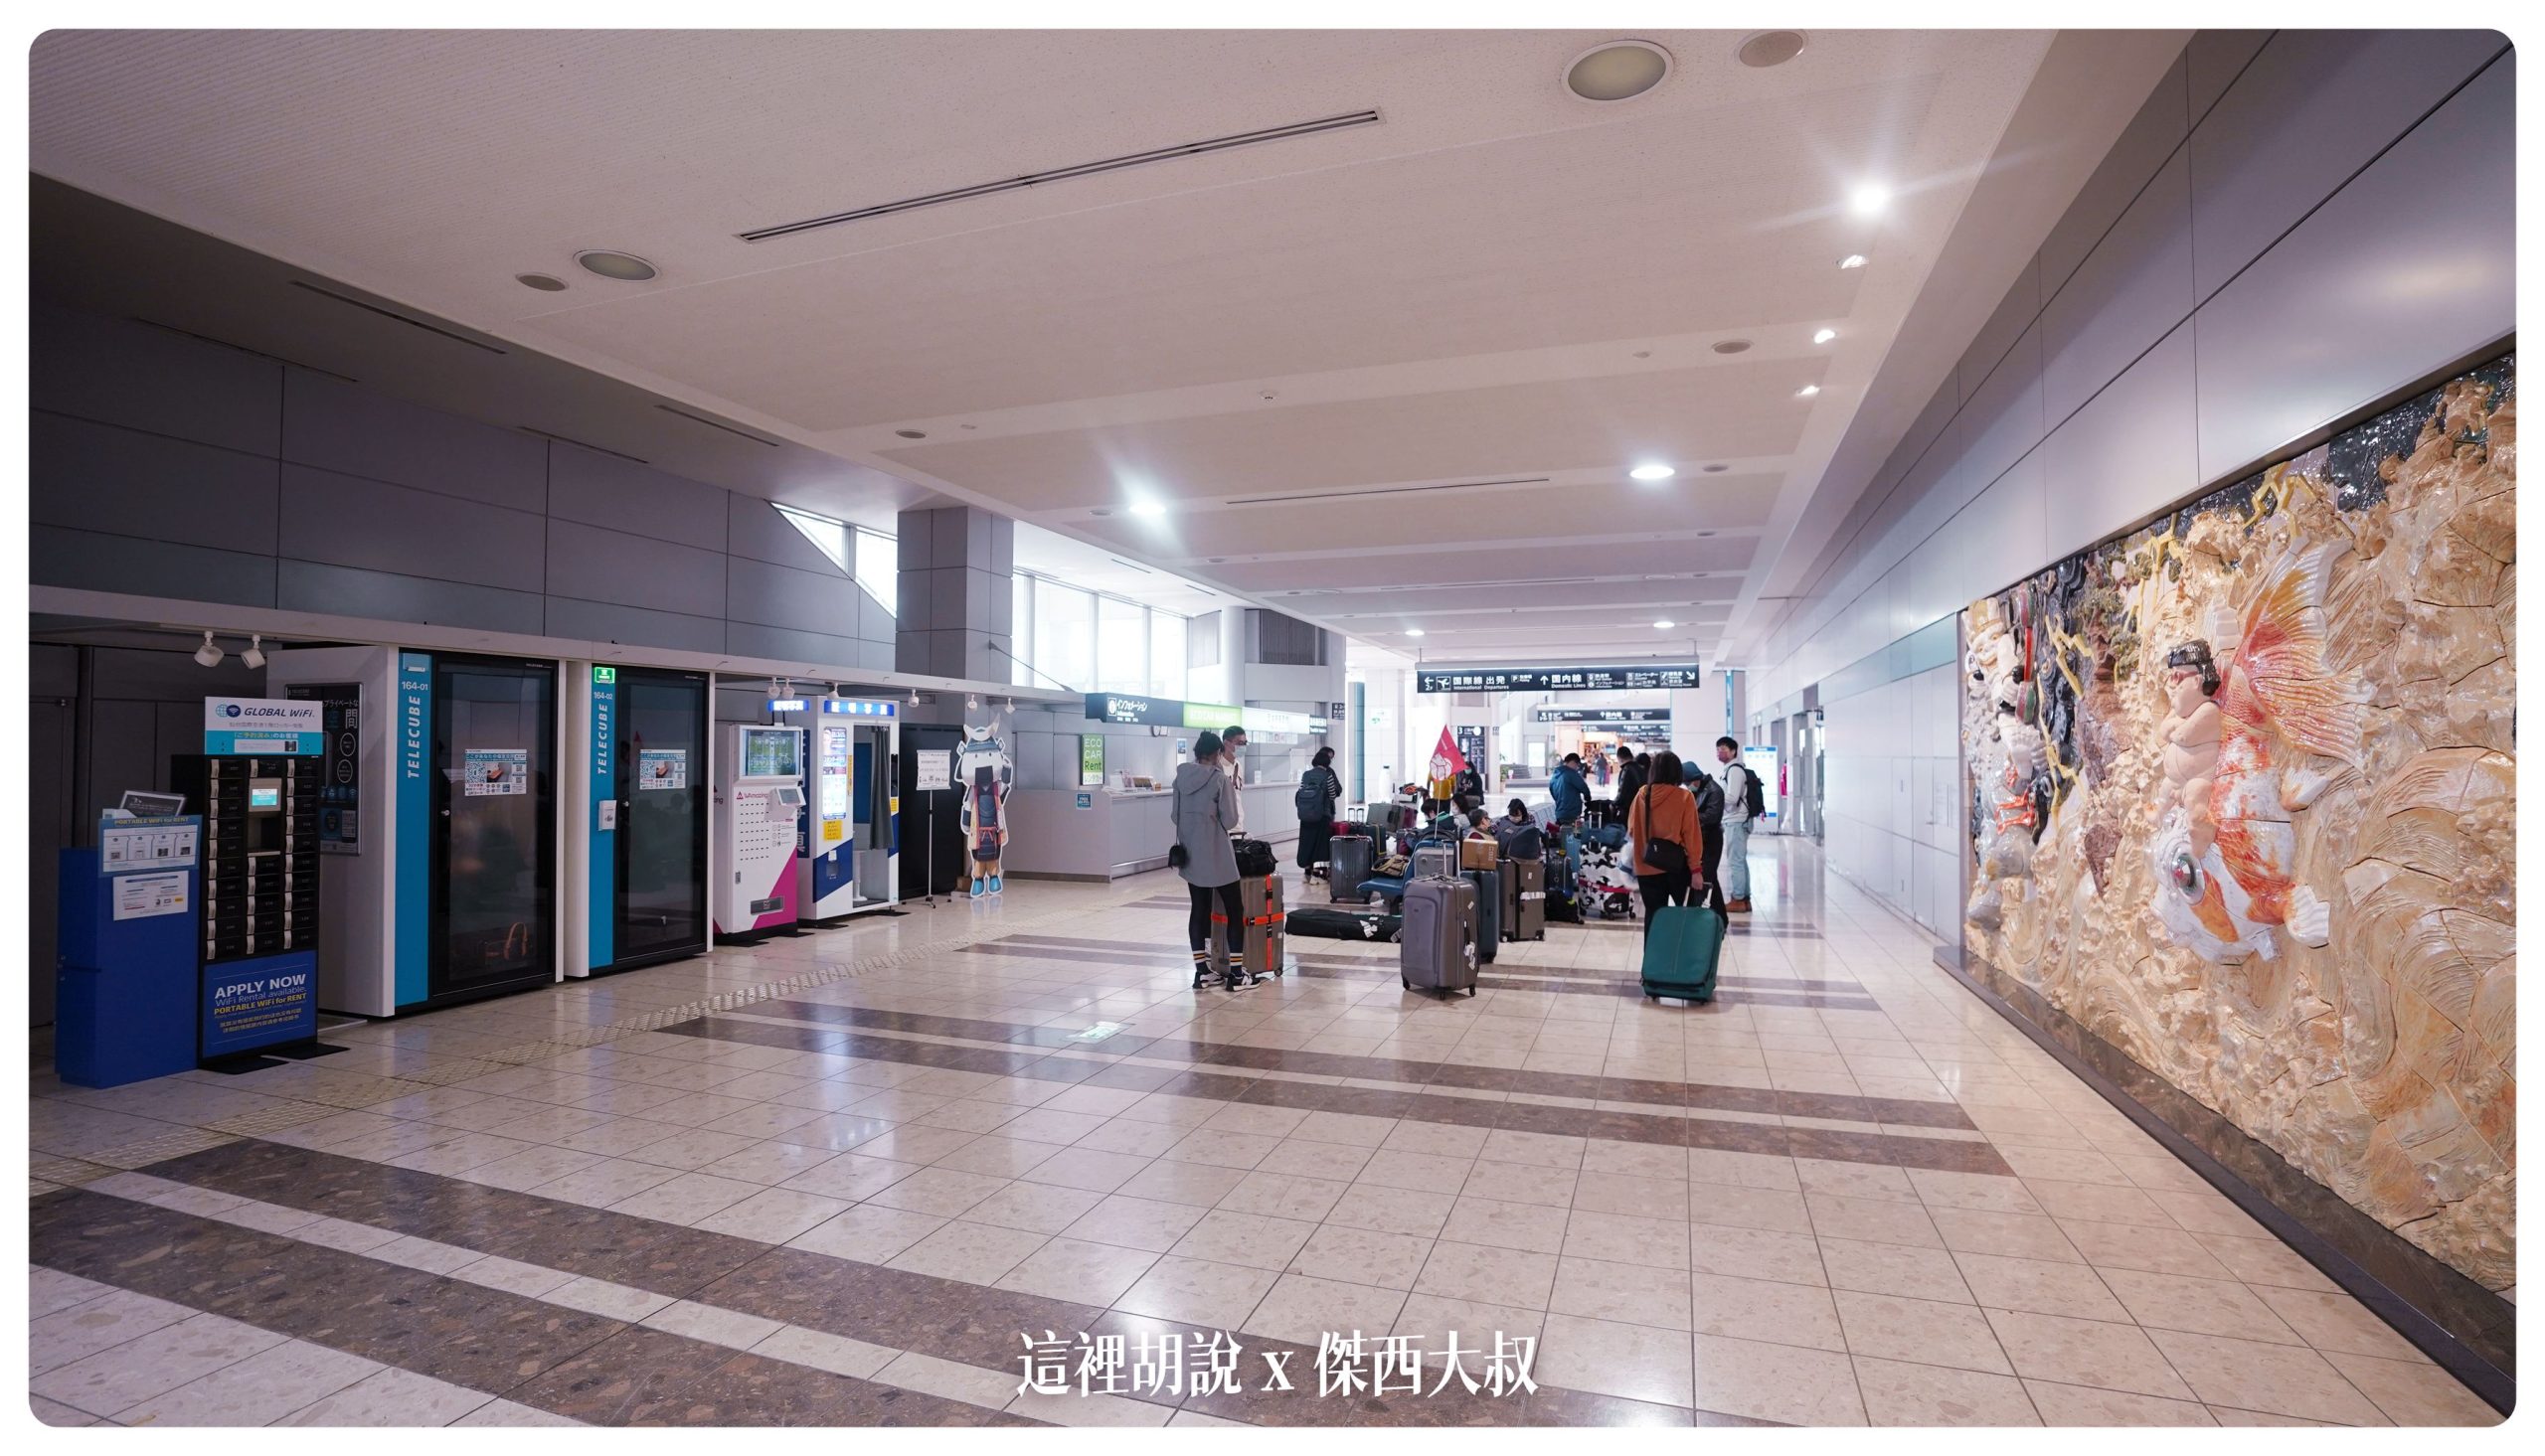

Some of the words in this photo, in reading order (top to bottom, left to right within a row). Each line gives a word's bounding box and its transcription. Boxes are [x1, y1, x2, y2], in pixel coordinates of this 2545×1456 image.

[402, 681, 428, 691] 164-01
[1452, 676, 1483, 686] 国際線
[244, 707, 287, 719] GLOBAL
[289, 708, 313, 719] WiFi
[408, 695, 421, 779] TELECUBE
[597, 704, 608, 775] TELECUBE
[1084, 737, 1103, 748] ECO
[1084, 749, 1103, 759] CAR
[1084, 760, 1103, 771] Rent
[214, 980, 265, 1000] APPLY
[269, 973, 306, 990] NOW
[214, 1003, 255, 1015] PORTABLE
[286, 993, 307, 1003] RENT
[239, 992, 265, 1004] Rental
